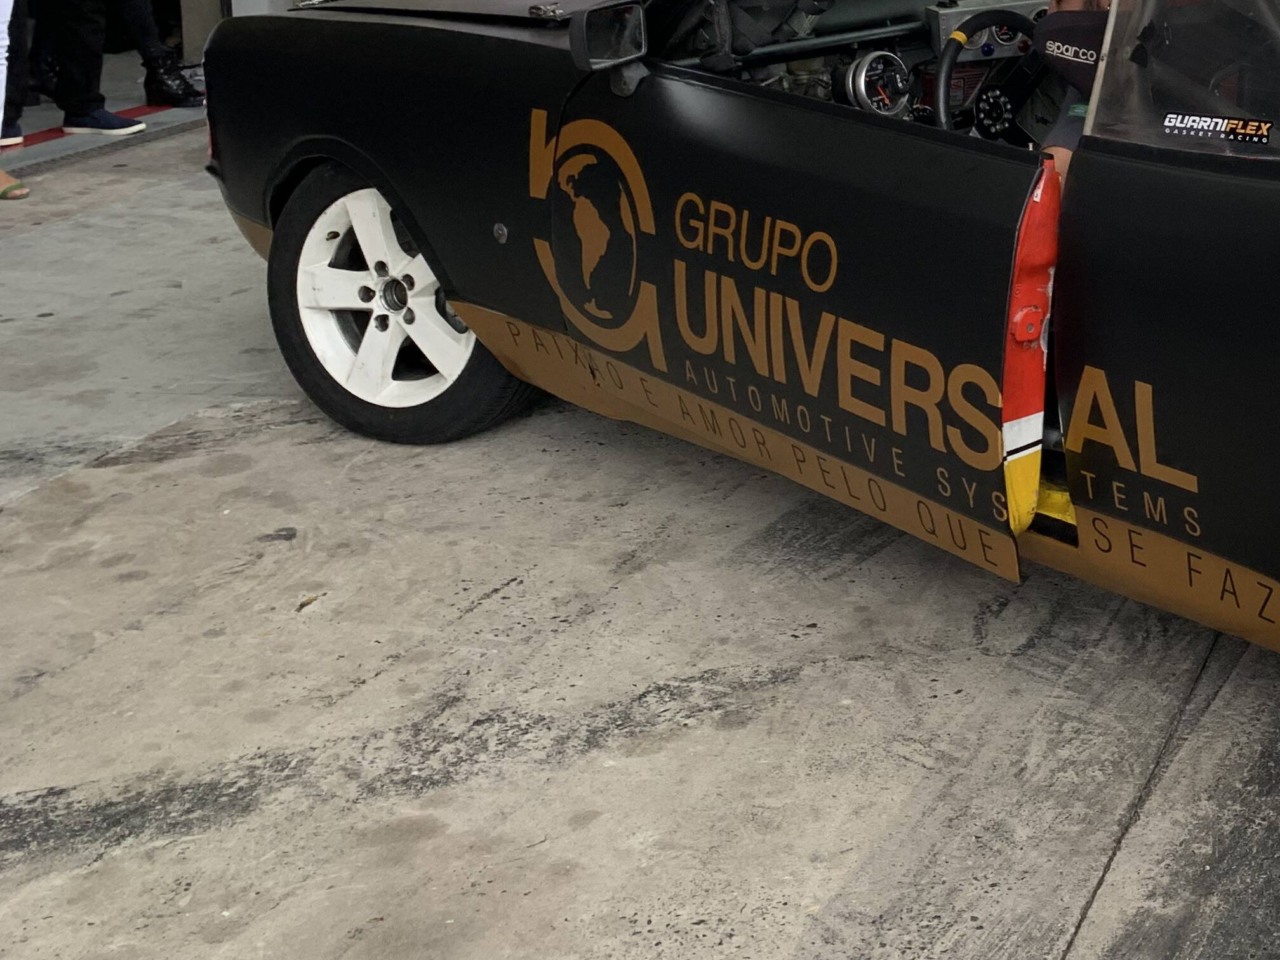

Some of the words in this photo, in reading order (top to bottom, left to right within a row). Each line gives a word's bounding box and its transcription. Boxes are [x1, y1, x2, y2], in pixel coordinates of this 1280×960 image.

[1045, 40, 1097, 62] sparco
[1163, 113, 1272, 136] GUARNIFLEX
[1165, 127, 1213, 138] GASKET
[1220, 133, 1268, 144] RACING
[675, 192, 838, 293] GRUPO
[686, 360, 905, 478] AUTOMOTIVE
[640, 377, 659, 408] E
[680, 393, 772, 462] AMOR
[793, 444, 888, 513] PELO
[916, 500, 999, 568] QUE
[1092, 516, 1147, 568] SE
[1186, 551, 1276, 624] FAZ
